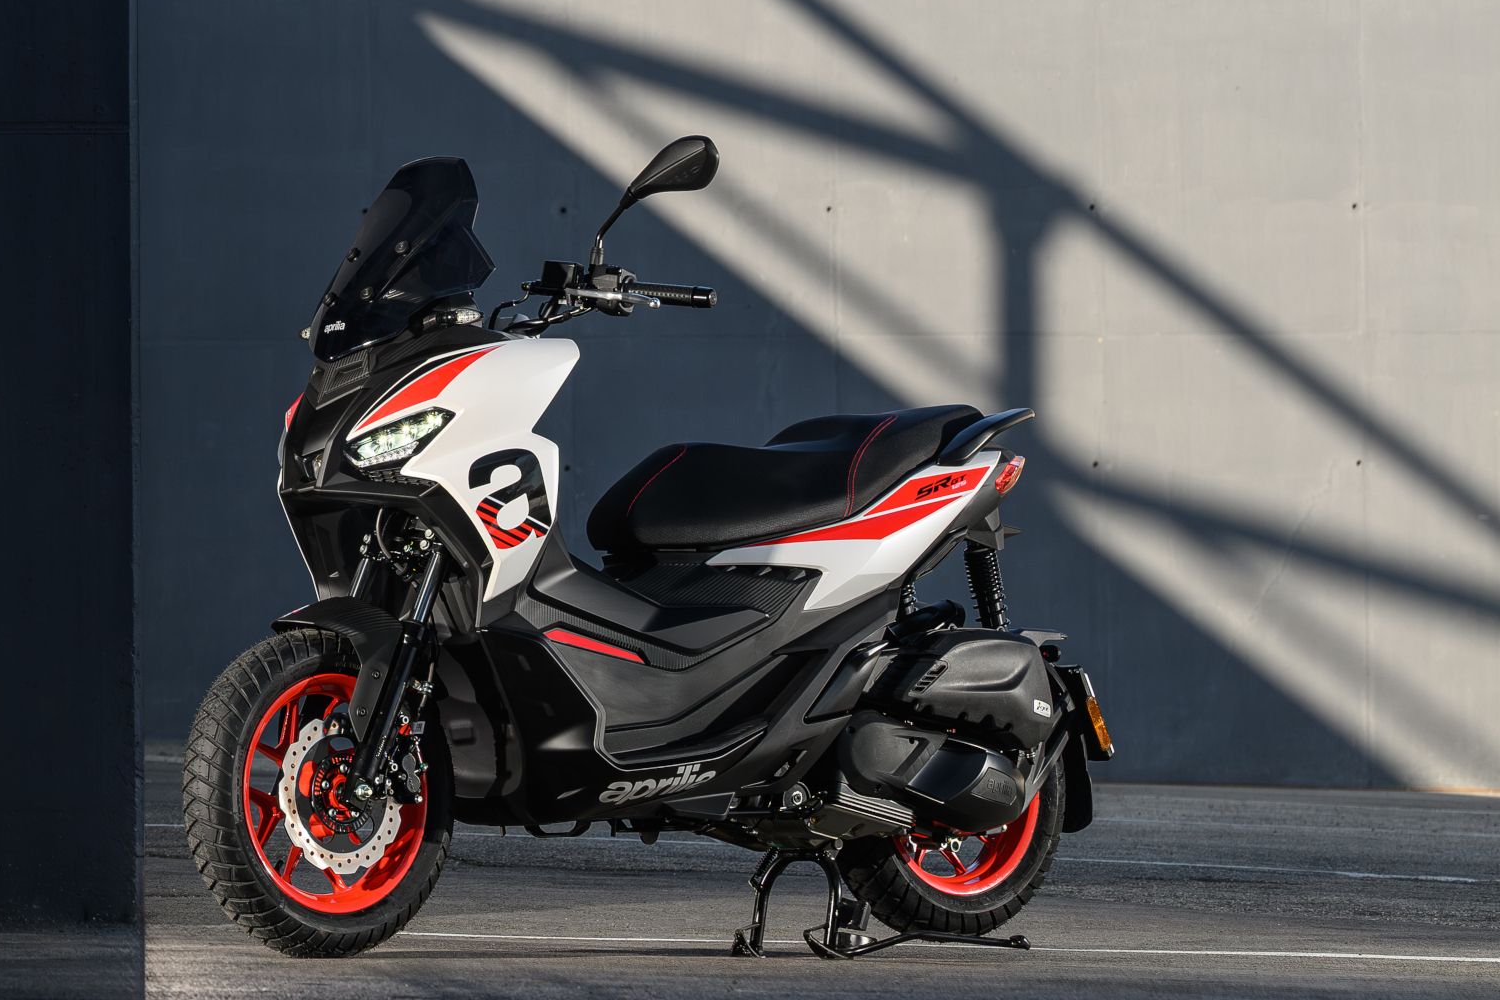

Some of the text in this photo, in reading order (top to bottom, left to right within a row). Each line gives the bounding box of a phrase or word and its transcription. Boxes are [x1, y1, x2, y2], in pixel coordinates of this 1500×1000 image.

[324, 320, 346, 334] aprilia
[914, 474, 967, 501] SR GT
[951, 480, 967, 490] 125
[468, 448, 552, 549] a
[986, 778, 1013, 797] aprilia
